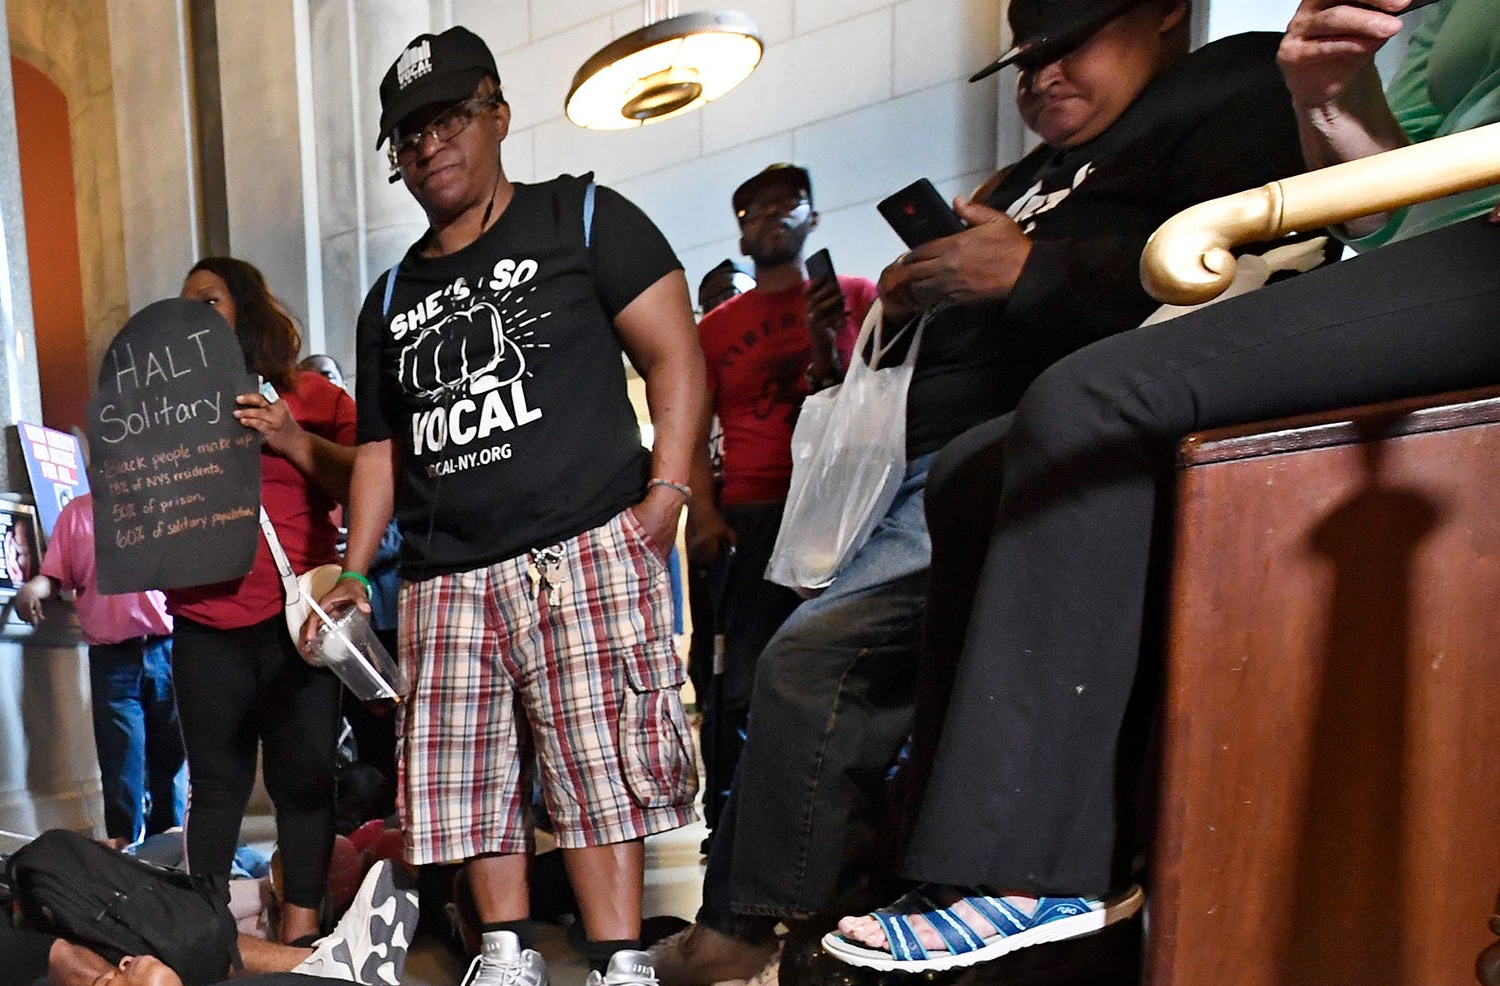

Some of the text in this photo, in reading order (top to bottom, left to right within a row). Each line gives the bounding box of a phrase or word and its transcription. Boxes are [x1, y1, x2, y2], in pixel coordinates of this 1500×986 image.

[398, 58, 433, 84] VOCAL
[390, 257, 539, 341] SHE'S SO
[111, 329, 211, 394] HALT
[100, 392, 221, 443] Solitary
[412, 380, 543, 456] VOCAL
[152, 444, 191, 469] people
[132, 477, 143, 491] of
[146, 473, 171, 488] NYS
[143, 498, 155, 514] of
[116, 524, 145, 548] 60%
[152, 521, 164, 538] of
